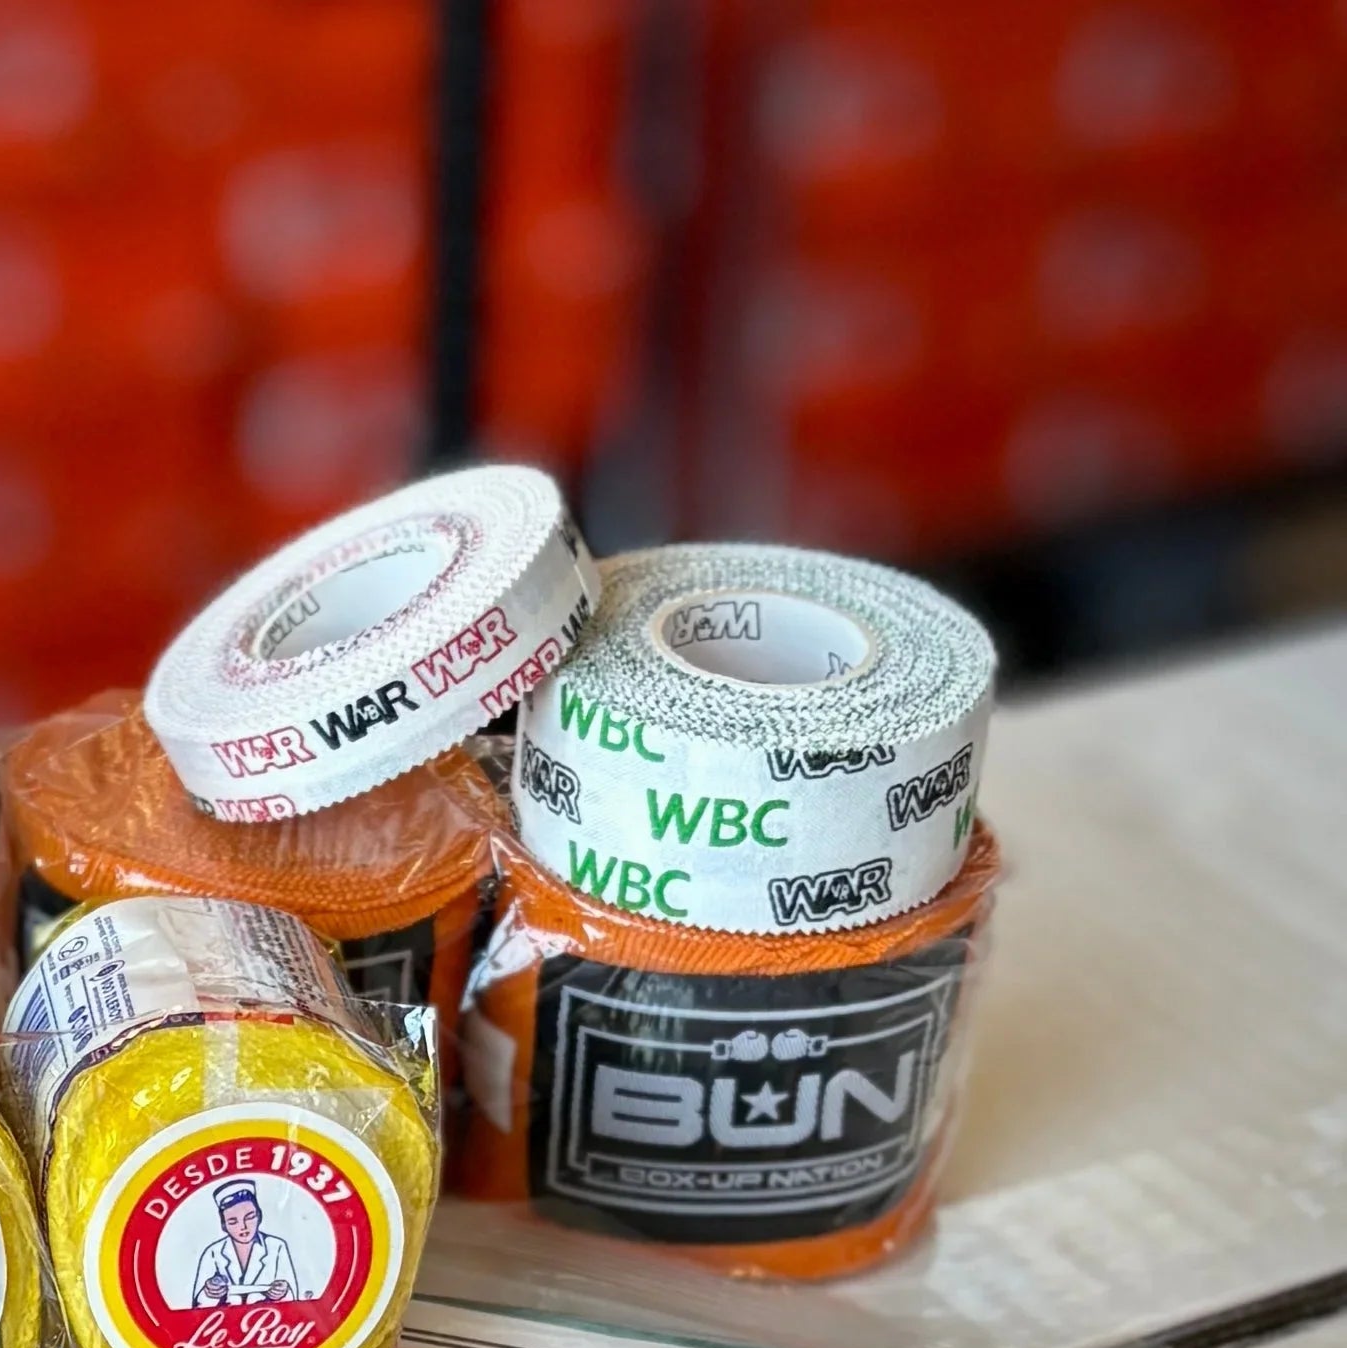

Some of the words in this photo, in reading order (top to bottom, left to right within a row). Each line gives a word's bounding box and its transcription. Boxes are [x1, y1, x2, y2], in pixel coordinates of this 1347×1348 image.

[210, 725, 317, 779] WAR
[308, 679, 419, 751] WAR
[412, 606, 518, 700] WAR
[560, 682, 666, 763] WBC
[646, 786, 791, 848] WBC
[567, 839, 692, 919] WBC
[768, 856, 893, 926] WAR
[144, 1146, 254, 1222] DESDE
[268, 1144, 353, 1205] 1937
[618, 1163, 763, 1190] BOX-UP
[770, 1152, 885, 1188] NATION
